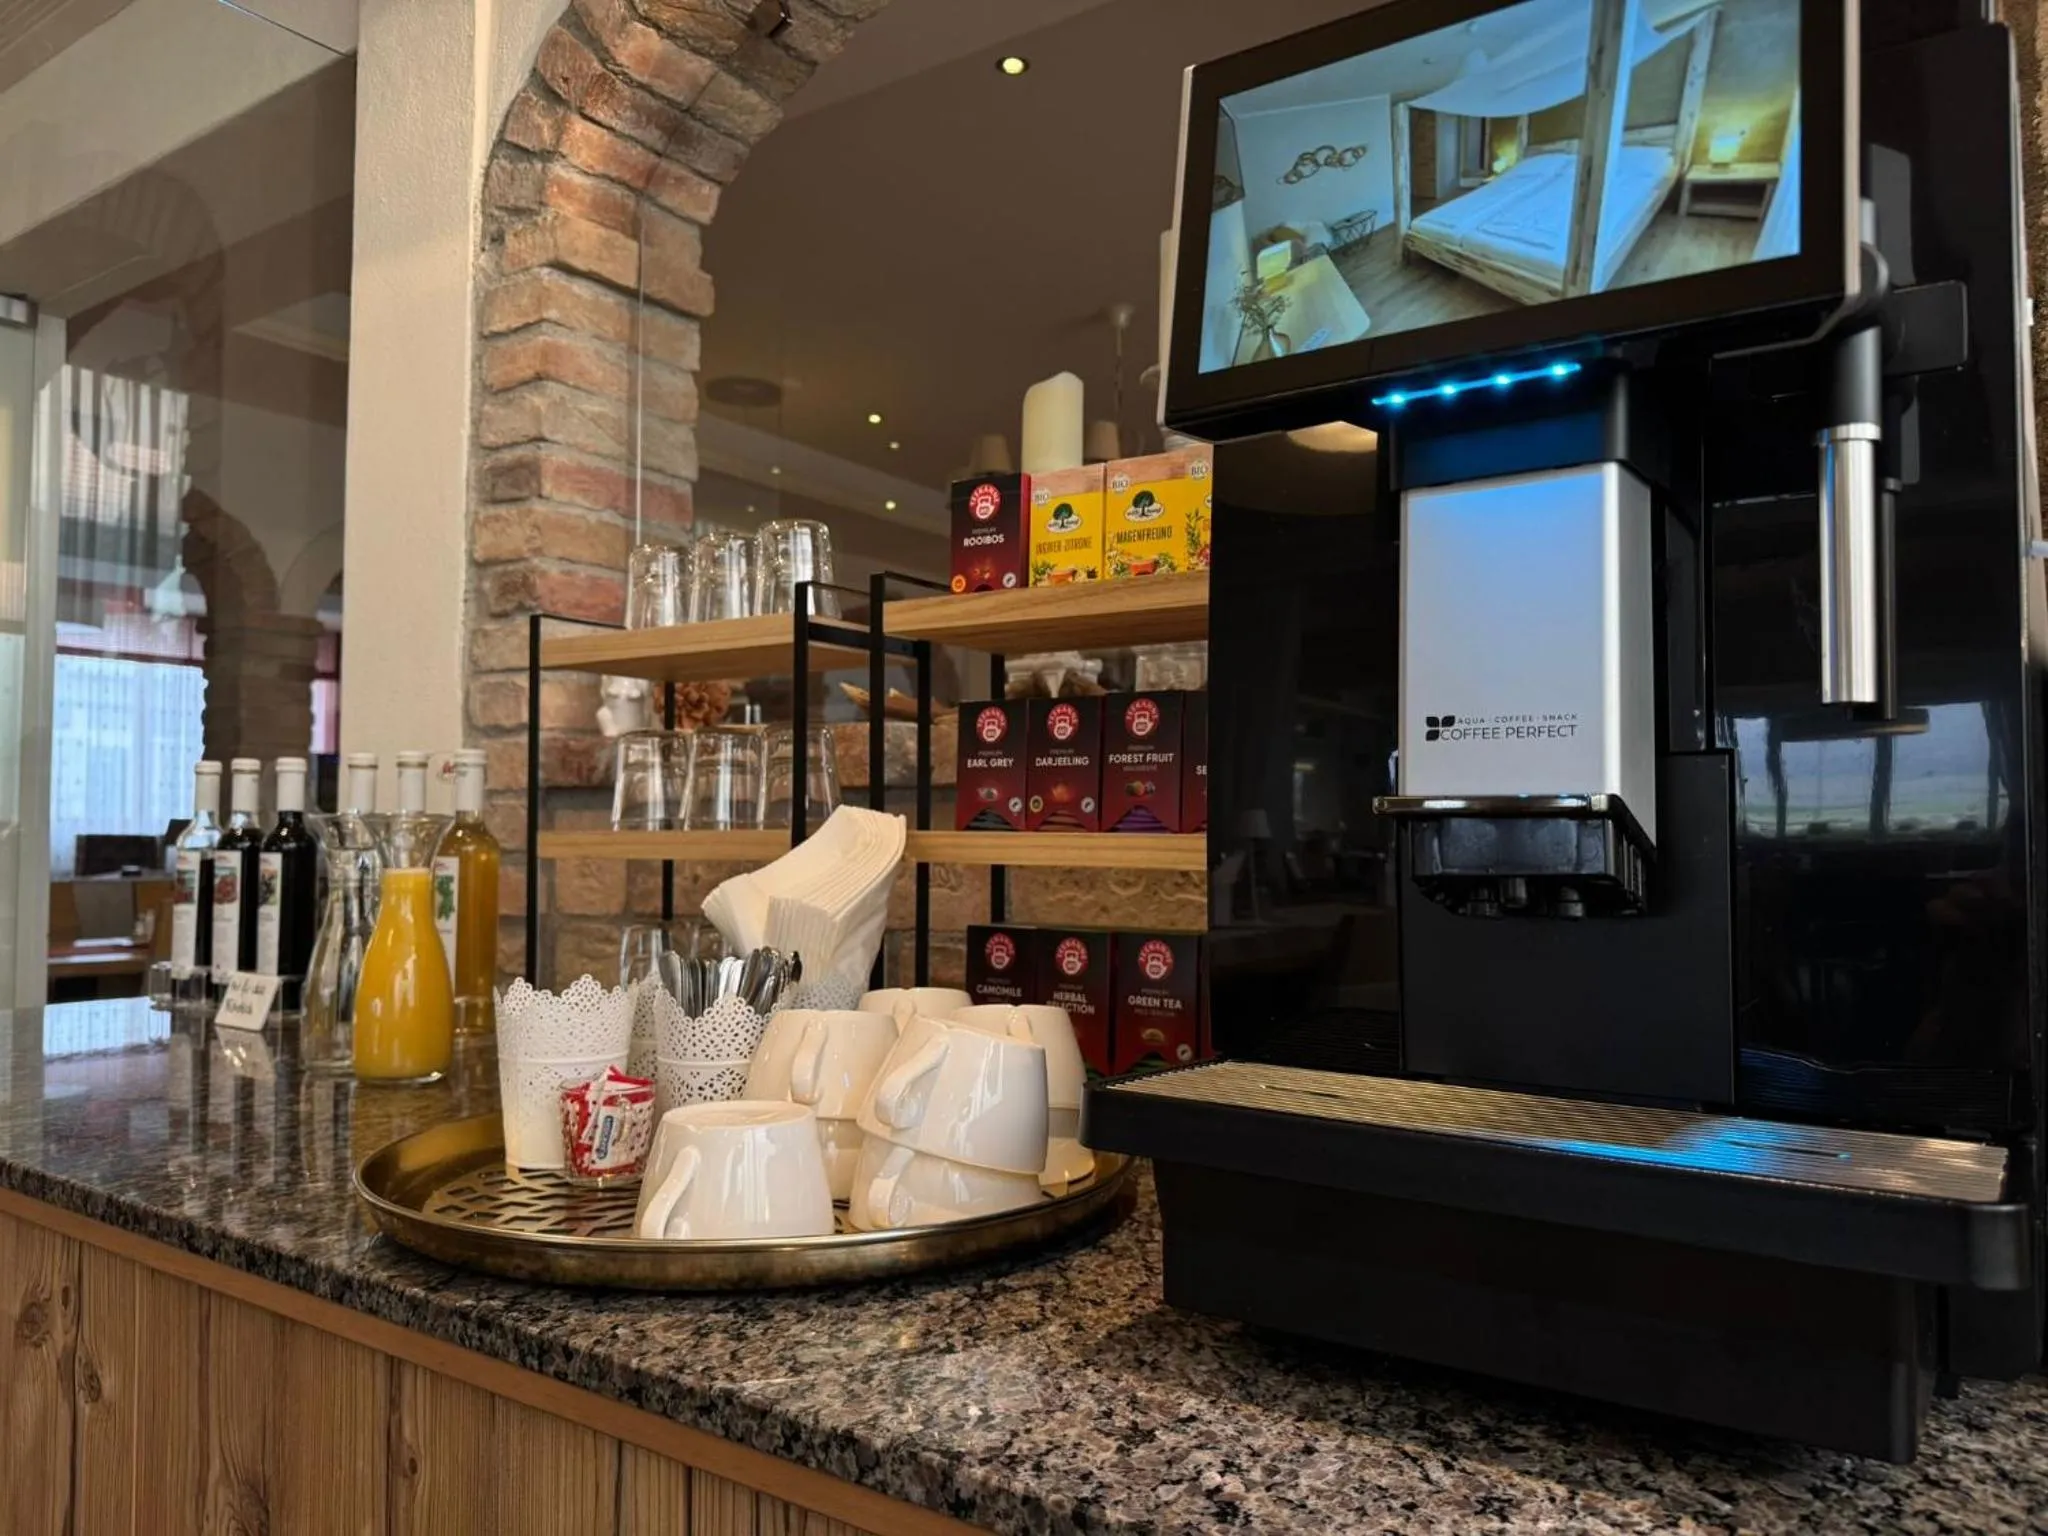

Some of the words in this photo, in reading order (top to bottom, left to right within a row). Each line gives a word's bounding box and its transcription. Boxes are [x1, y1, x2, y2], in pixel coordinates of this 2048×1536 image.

[963, 533, 1004, 547] ROOIBOS
[1116, 525, 1173, 544] MAGENFREUND
[1458, 717, 1485, 726] AQUA
[1495, 715, 1534, 724] COFFEE
[1542, 713, 1578, 722] SNACK
[1440, 727, 1501, 741] COFFEE
[1505, 724, 1579, 739] PERFECT
[967, 758, 988, 769] EARL
[989, 757, 1014, 768] GREY
[1035, 756, 1090, 767] DARJEELING
[1109, 754, 1144, 764] FOREST
[1146, 752, 1175, 764] FRUIT
[976, 984, 1022, 997] CAMOMILE
[1053, 991, 1087, 1003] HERBAL
[1128, 995, 1160, 1009] GREEN
[1162, 998, 1182, 1010] TEA
